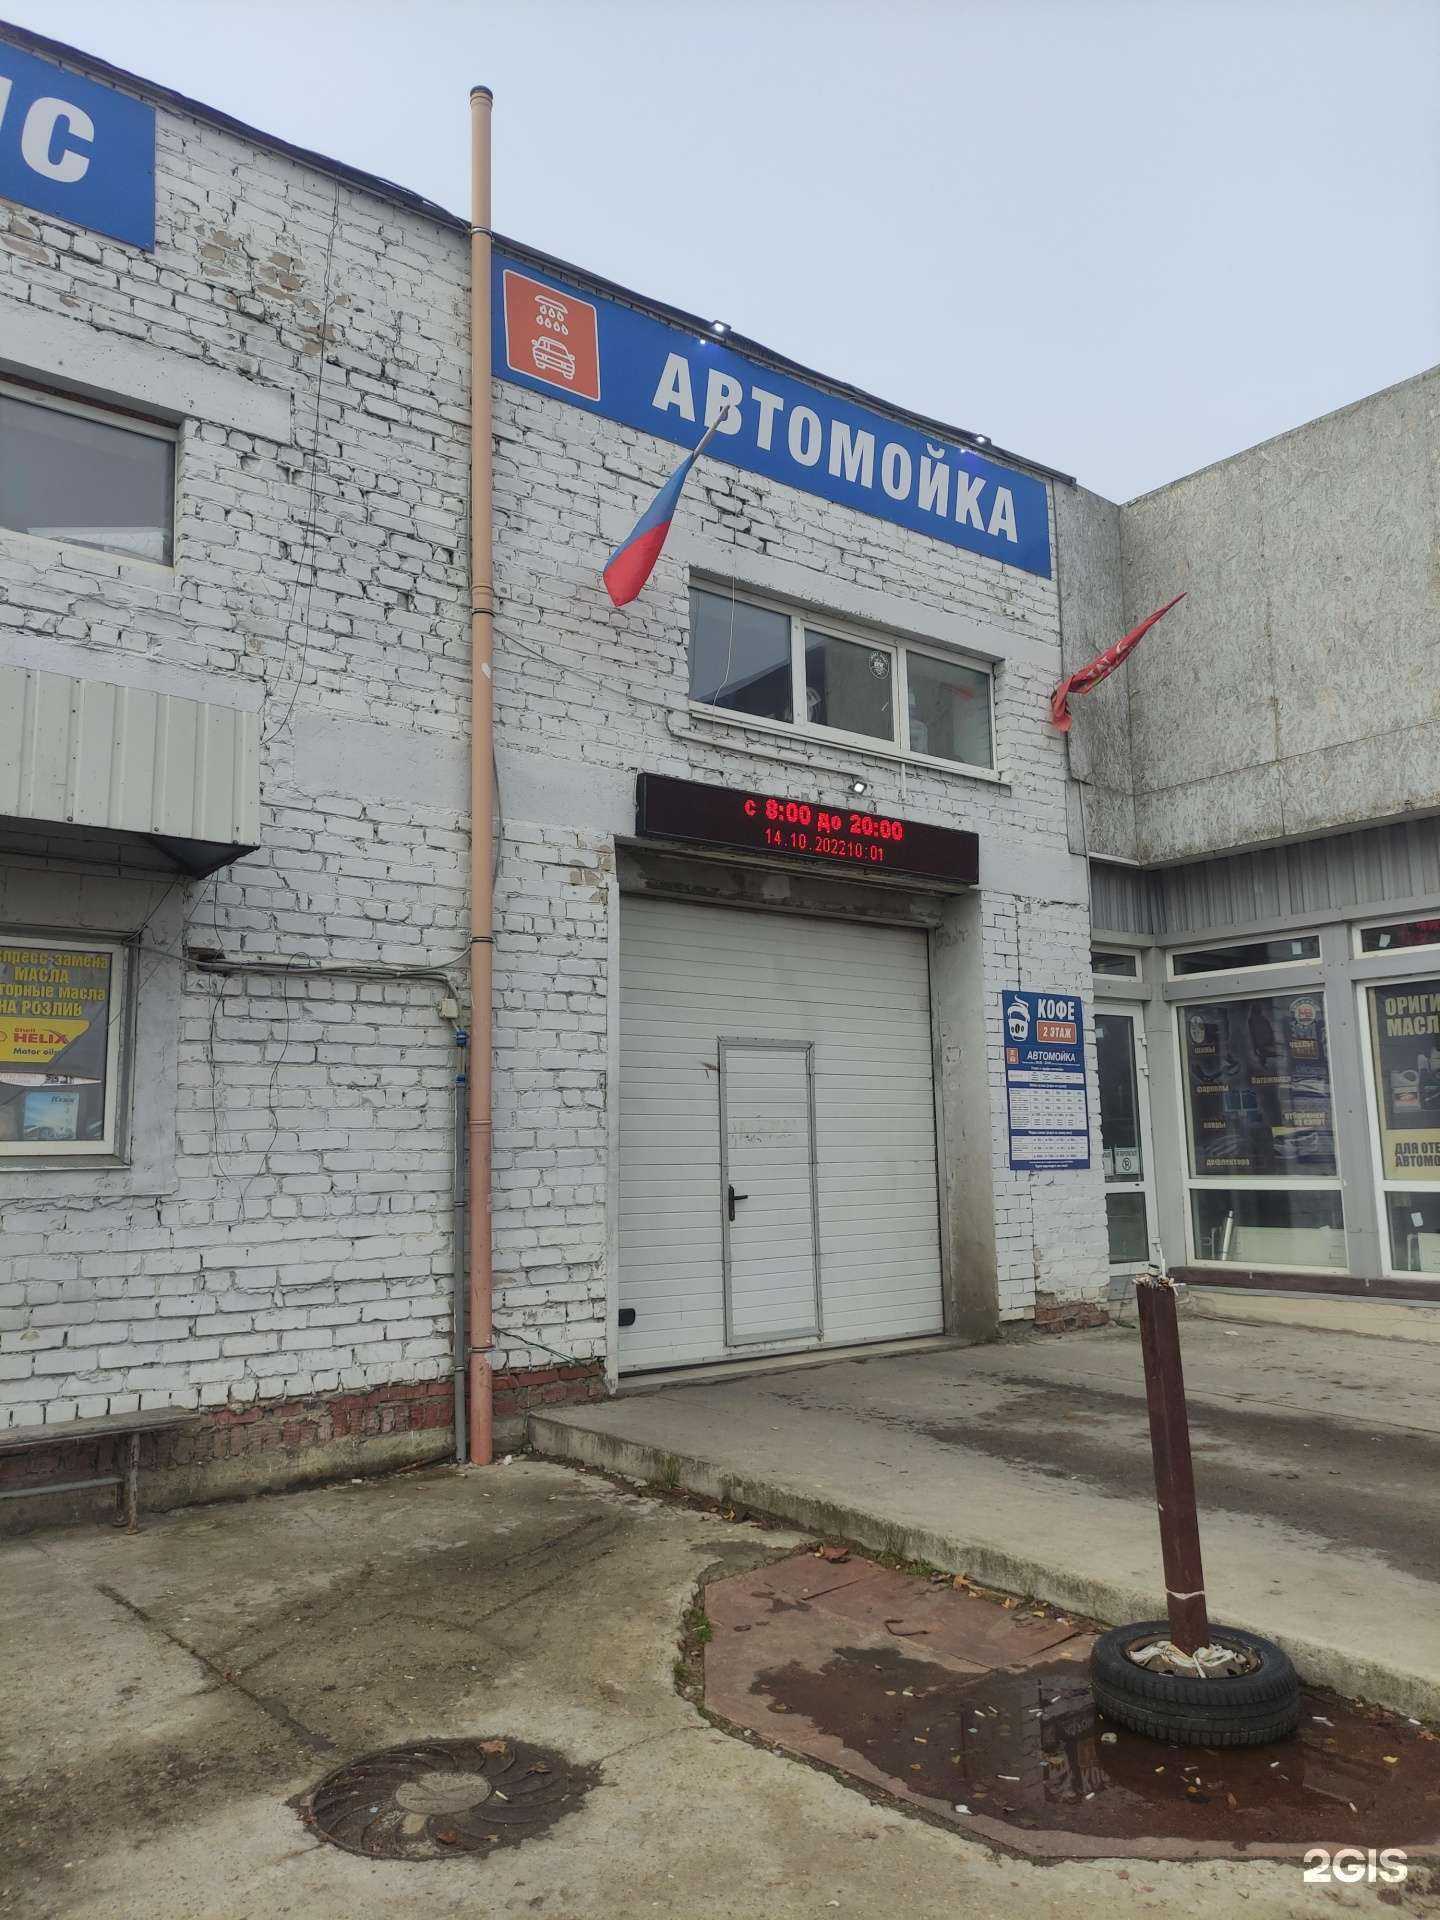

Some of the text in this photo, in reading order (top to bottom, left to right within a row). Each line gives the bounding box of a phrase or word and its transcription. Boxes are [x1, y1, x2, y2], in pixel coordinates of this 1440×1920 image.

[651, 352, 1019, 544] АВТОМОЙКА
[765, 799, 812, 826] 8:00
[850, 814, 904, 841] 20:00
[0, 950, 108, 968] пресс-замена
[15, 966, 70, 983] МАСЛА
[22, 1000, 82, 1016] РОЗЛИВ
[1037, 998, 1075, 1020] КОФЕ
[14, 1033, 69, 1044] HELIX
[1042, 1025, 1072, 1039] 2 ЭТАЖ
[13, 1047, 40, 1056] Motor
[1027, 1050, 1076, 1062] АВТОМОЙКА
[1395, 1142, 1419, 1155] ДЛЯ
